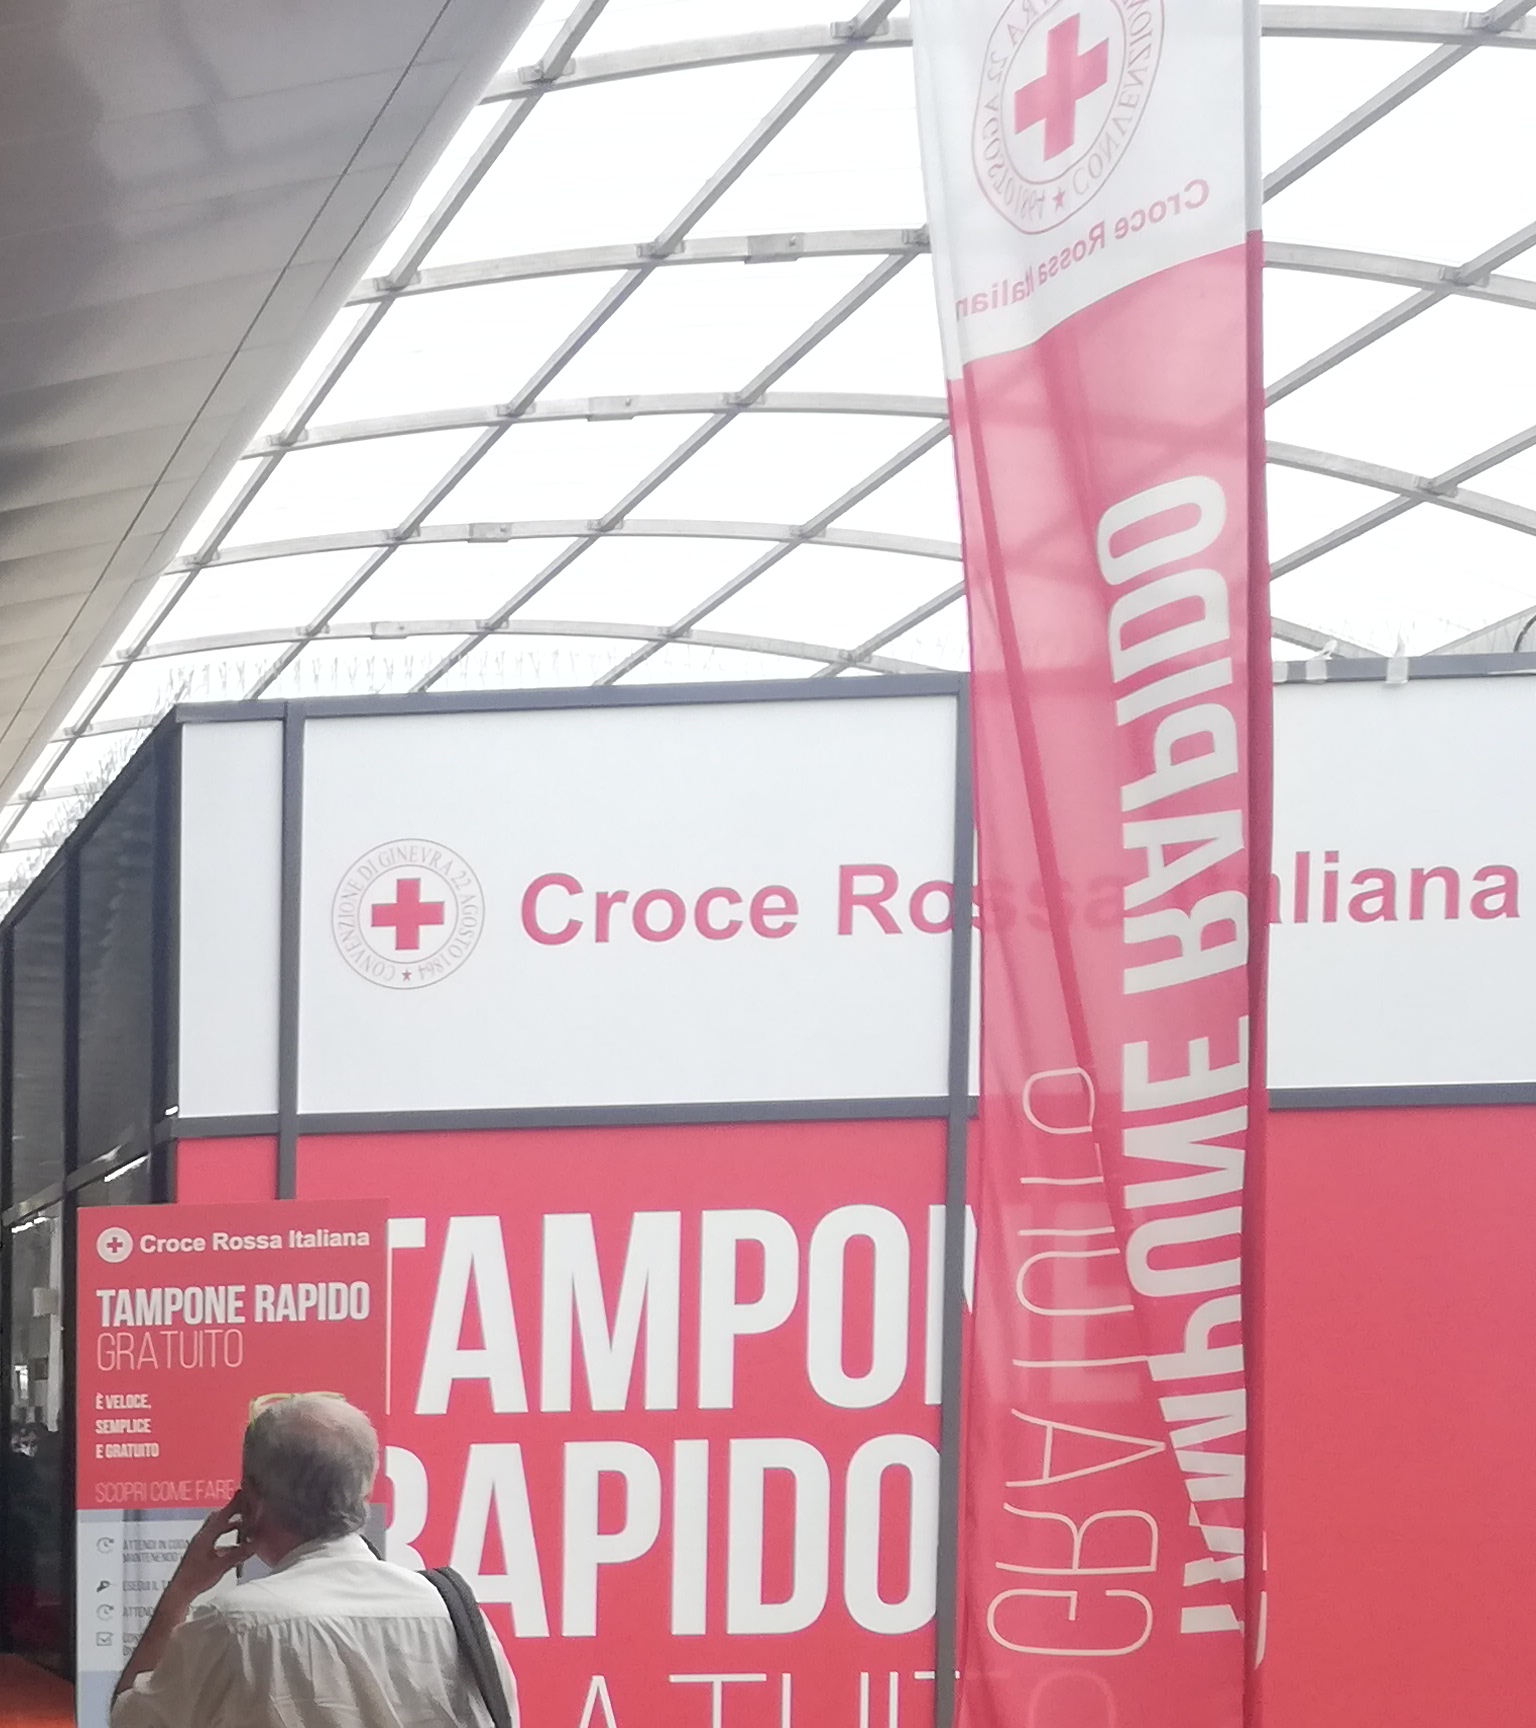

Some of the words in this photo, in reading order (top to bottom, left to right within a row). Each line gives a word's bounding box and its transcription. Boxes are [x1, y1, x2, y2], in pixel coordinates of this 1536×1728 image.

[521, 872, 799, 946] Croce
[1269, 850, 1521, 925] liana
[139, 1232, 205, 1254] Croce
[212, 1231, 282, 1252] Rossa
[288, 1228, 370, 1249] Italiana
[96, 1285, 246, 1328] TAMPONE
[255, 1281, 370, 1323] RAPIDO
[96, 1328, 244, 1372] GRATUITO
[95, 1418, 152, 1434] SEMPLICE
[95, 1444, 104, 1459] E
[105, 1442, 160, 1459] GRATUITO
[95, 1481, 147, 1503] SCOPRI
[150, 1480, 193, 1502] COME
